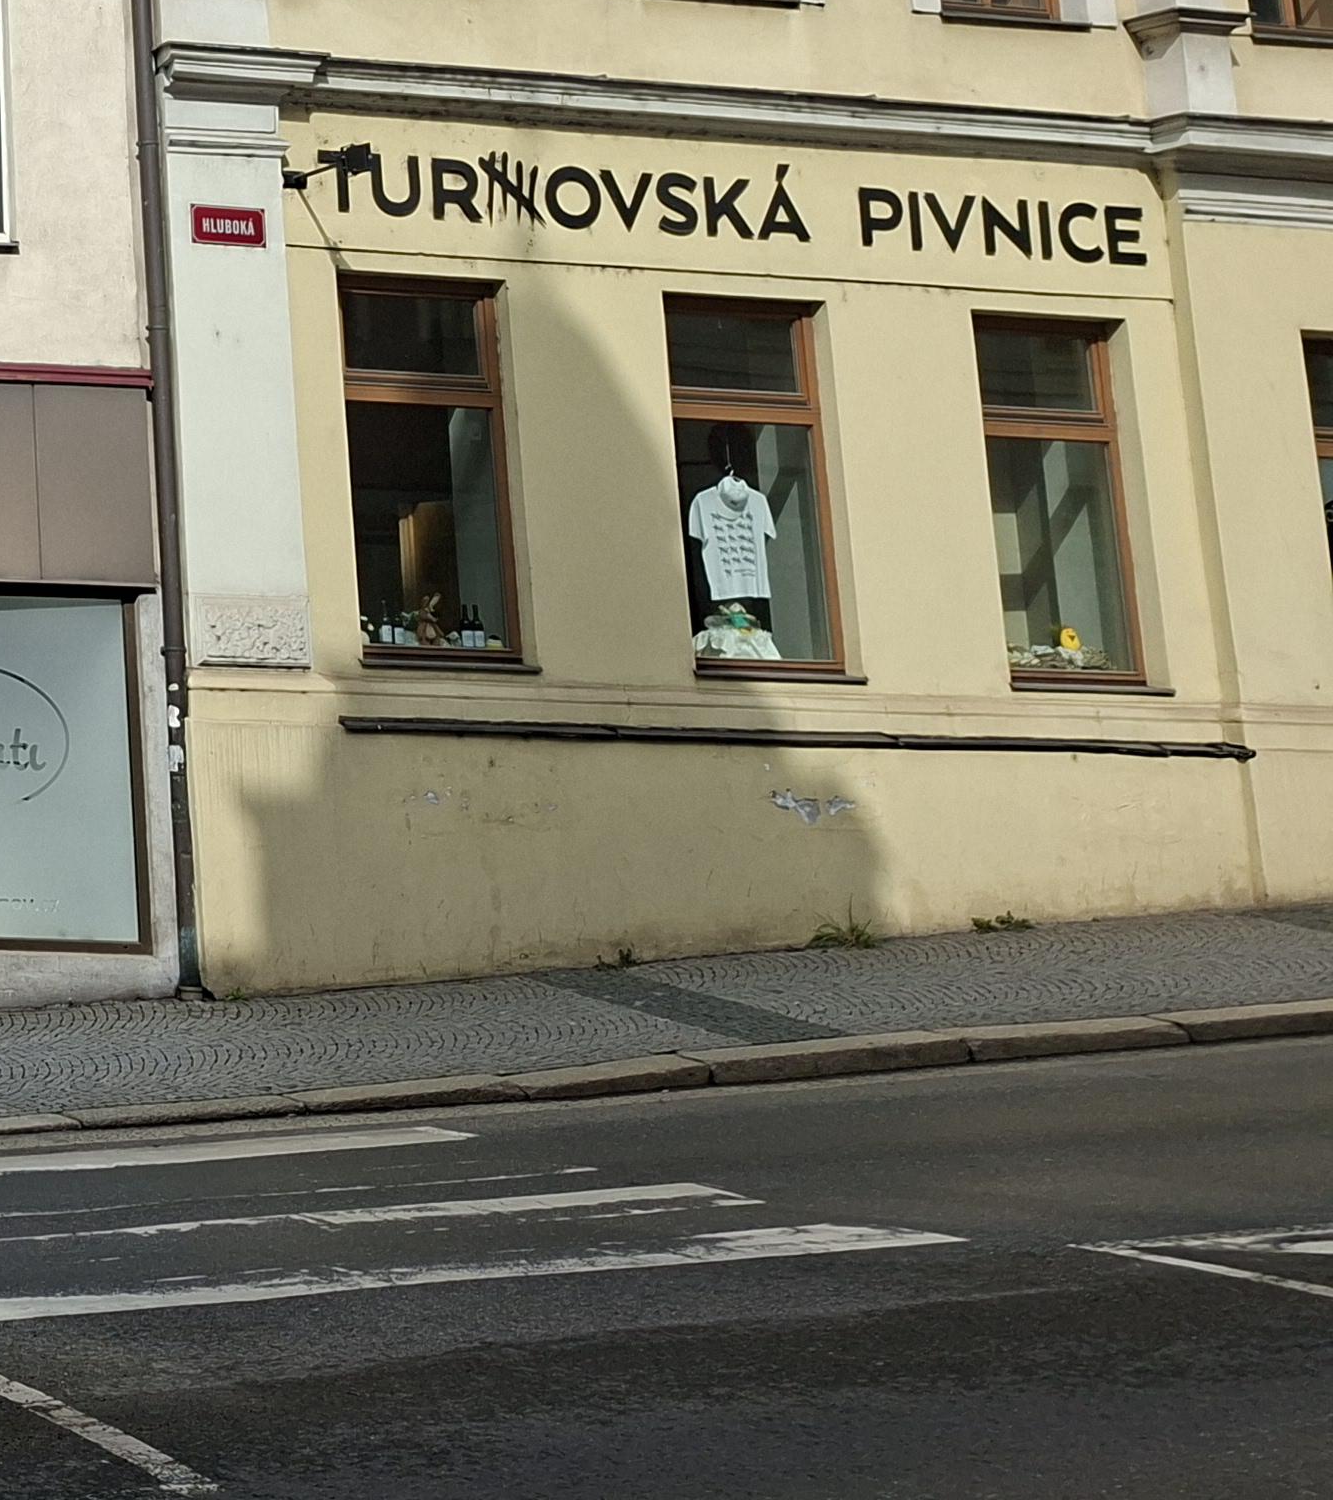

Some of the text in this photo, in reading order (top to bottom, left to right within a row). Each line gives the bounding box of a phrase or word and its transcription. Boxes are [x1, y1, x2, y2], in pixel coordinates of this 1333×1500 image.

[202, 217, 255, 236] HLUBOKÁ
[317, 149, 1148, 266] TURNOVSKÁ PIVNICE
